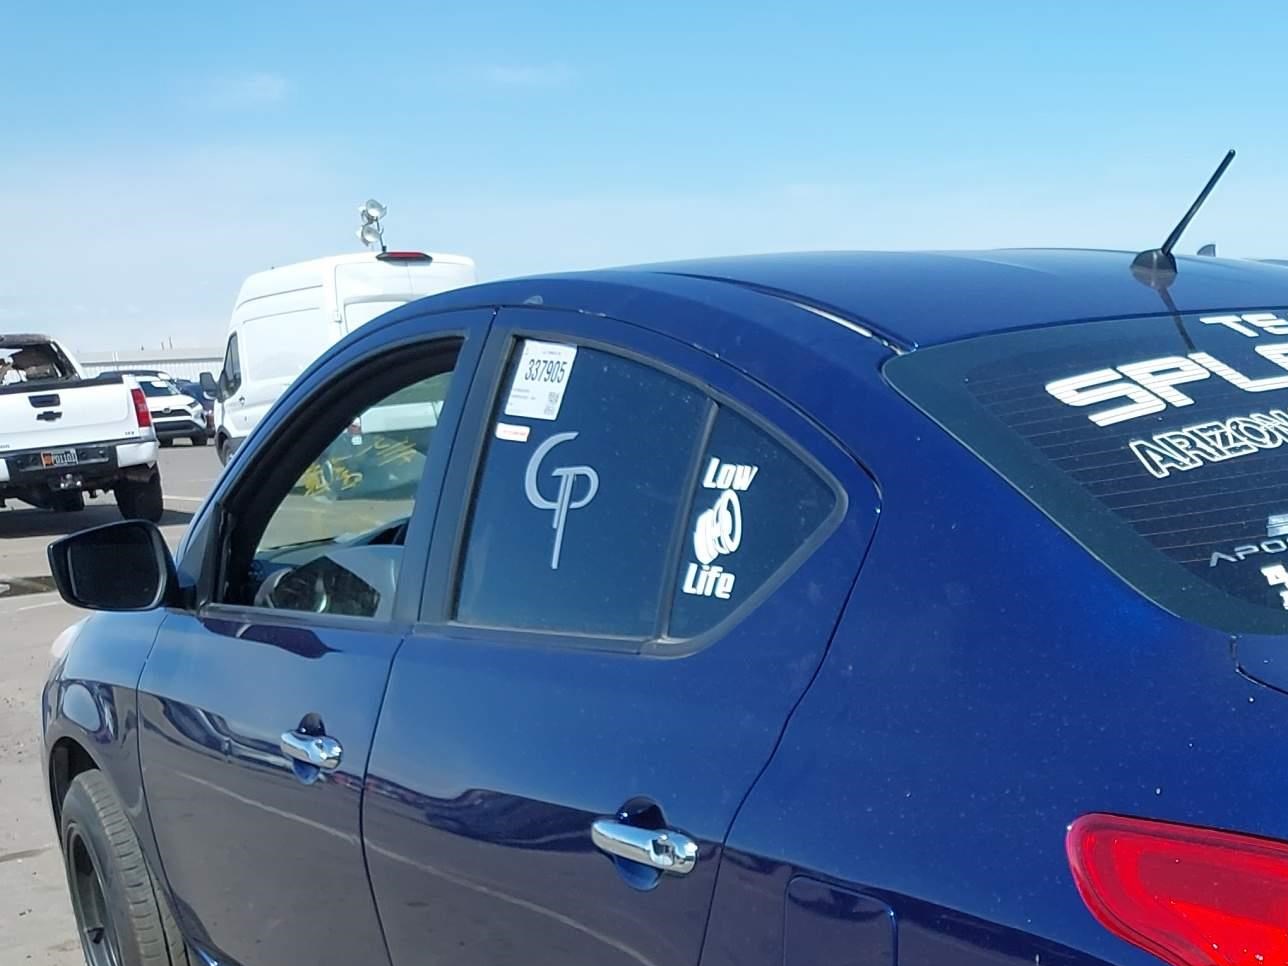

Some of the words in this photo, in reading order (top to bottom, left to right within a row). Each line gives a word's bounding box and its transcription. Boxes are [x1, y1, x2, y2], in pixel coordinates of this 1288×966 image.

[524, 359, 568, 384] 337905
[703, 457, 758, 491] Low
[683, 563, 735, 600] Life
